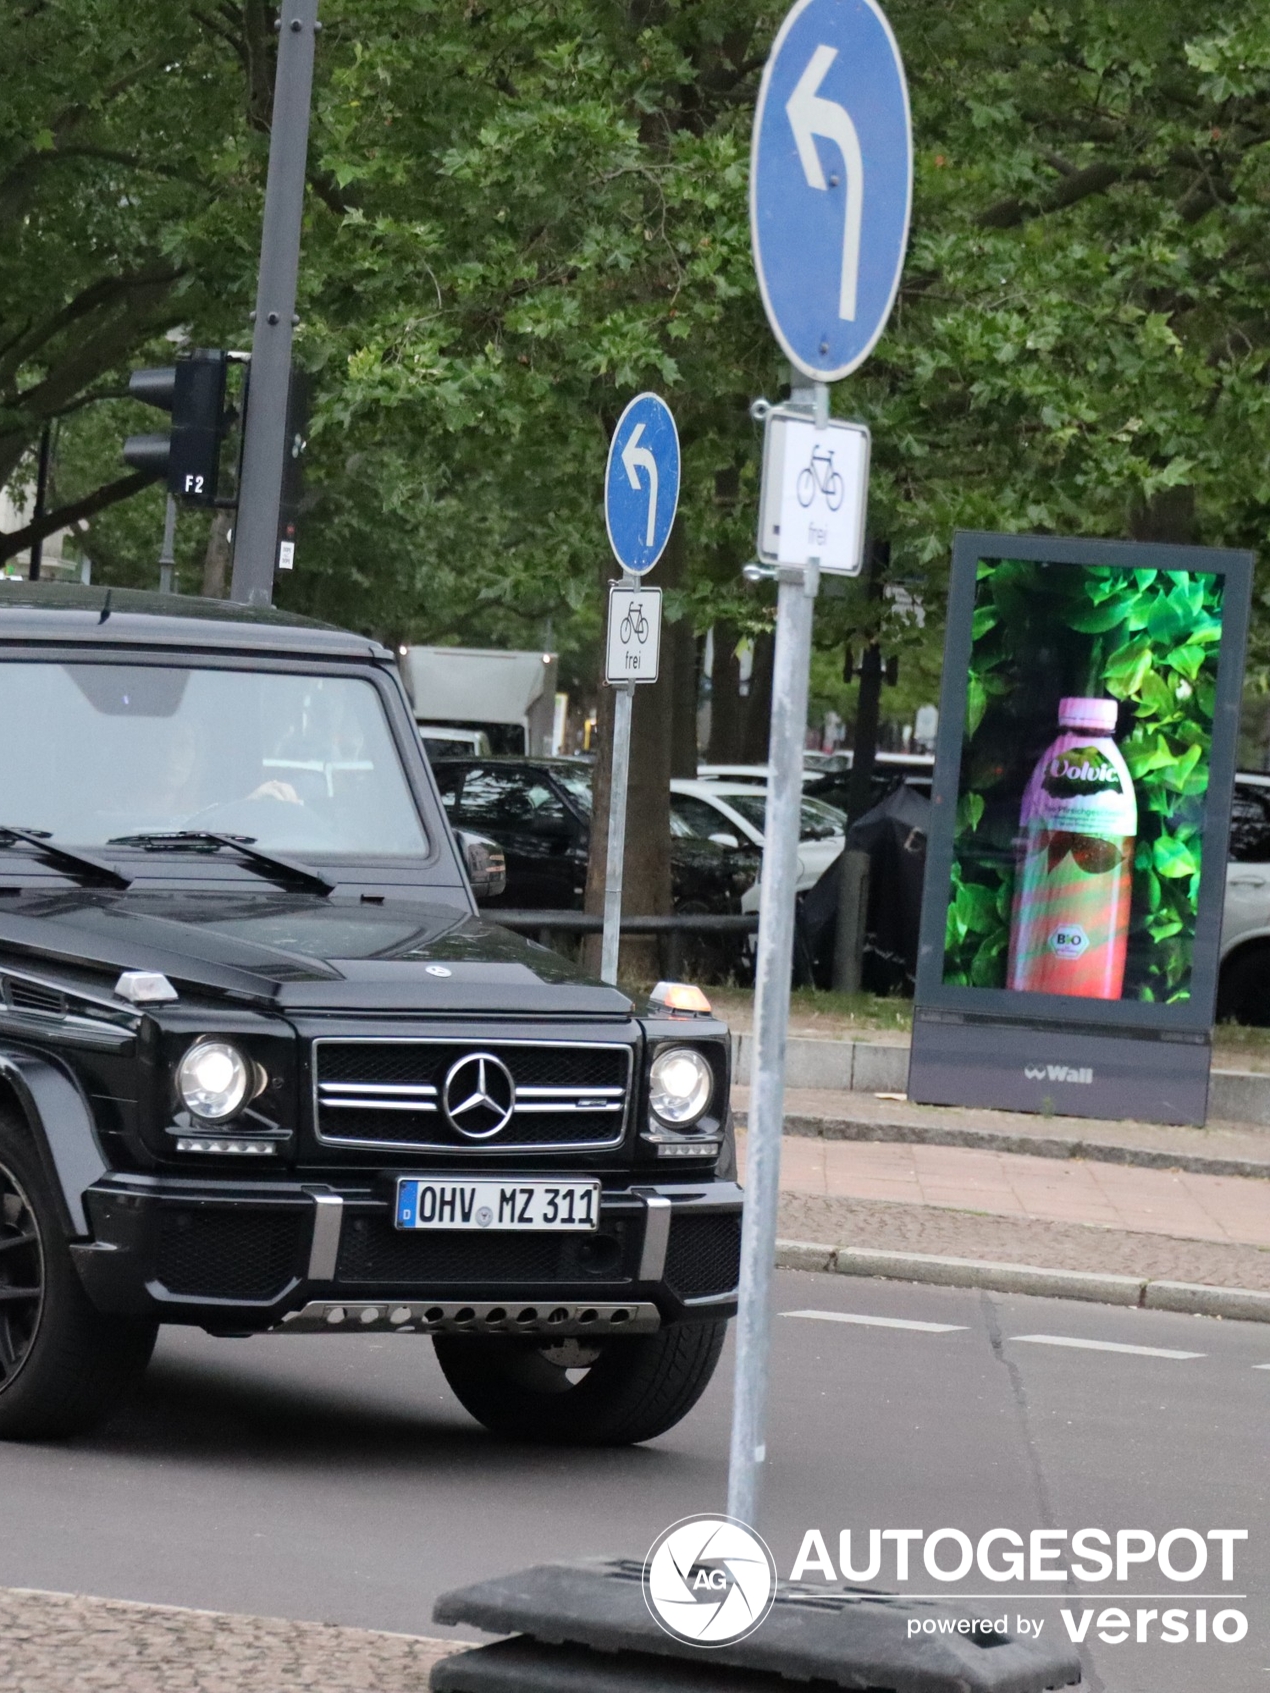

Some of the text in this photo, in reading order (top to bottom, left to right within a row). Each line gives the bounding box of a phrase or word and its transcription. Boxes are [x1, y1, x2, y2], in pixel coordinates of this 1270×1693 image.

[185, 475, 204, 493] F2
[808, 521, 828, 545] frei
[625, 650, 641, 669] frei
[1046, 1065, 1093, 1084] Wall
[419, 1186, 476, 1223] OHV
[498, 1188, 535, 1223] MZ
[542, 1189, 594, 1224] 311
